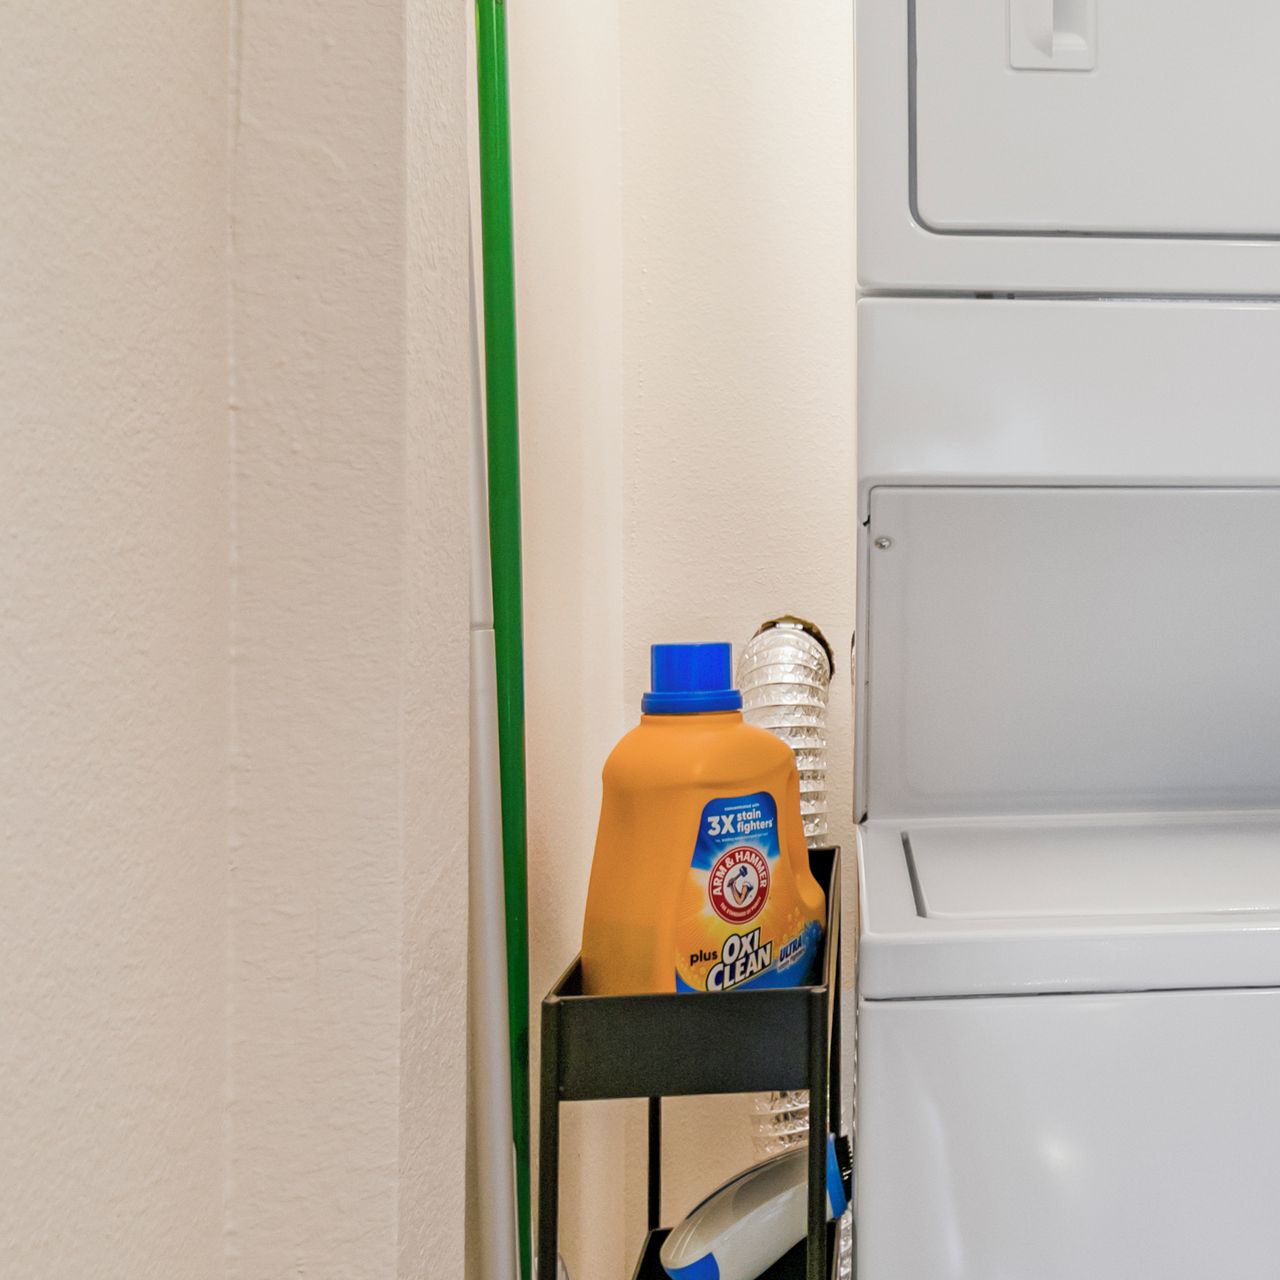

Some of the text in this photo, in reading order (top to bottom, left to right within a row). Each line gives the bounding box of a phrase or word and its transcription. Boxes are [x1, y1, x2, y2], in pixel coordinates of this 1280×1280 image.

[707, 808, 762, 836] 3X stain
[713, 851, 767, 896] ARM & HAMMER
[690, 949, 718, 967] plus
[706, 941, 773, 991] CLEAN
[722, 928, 761, 966] OXI
